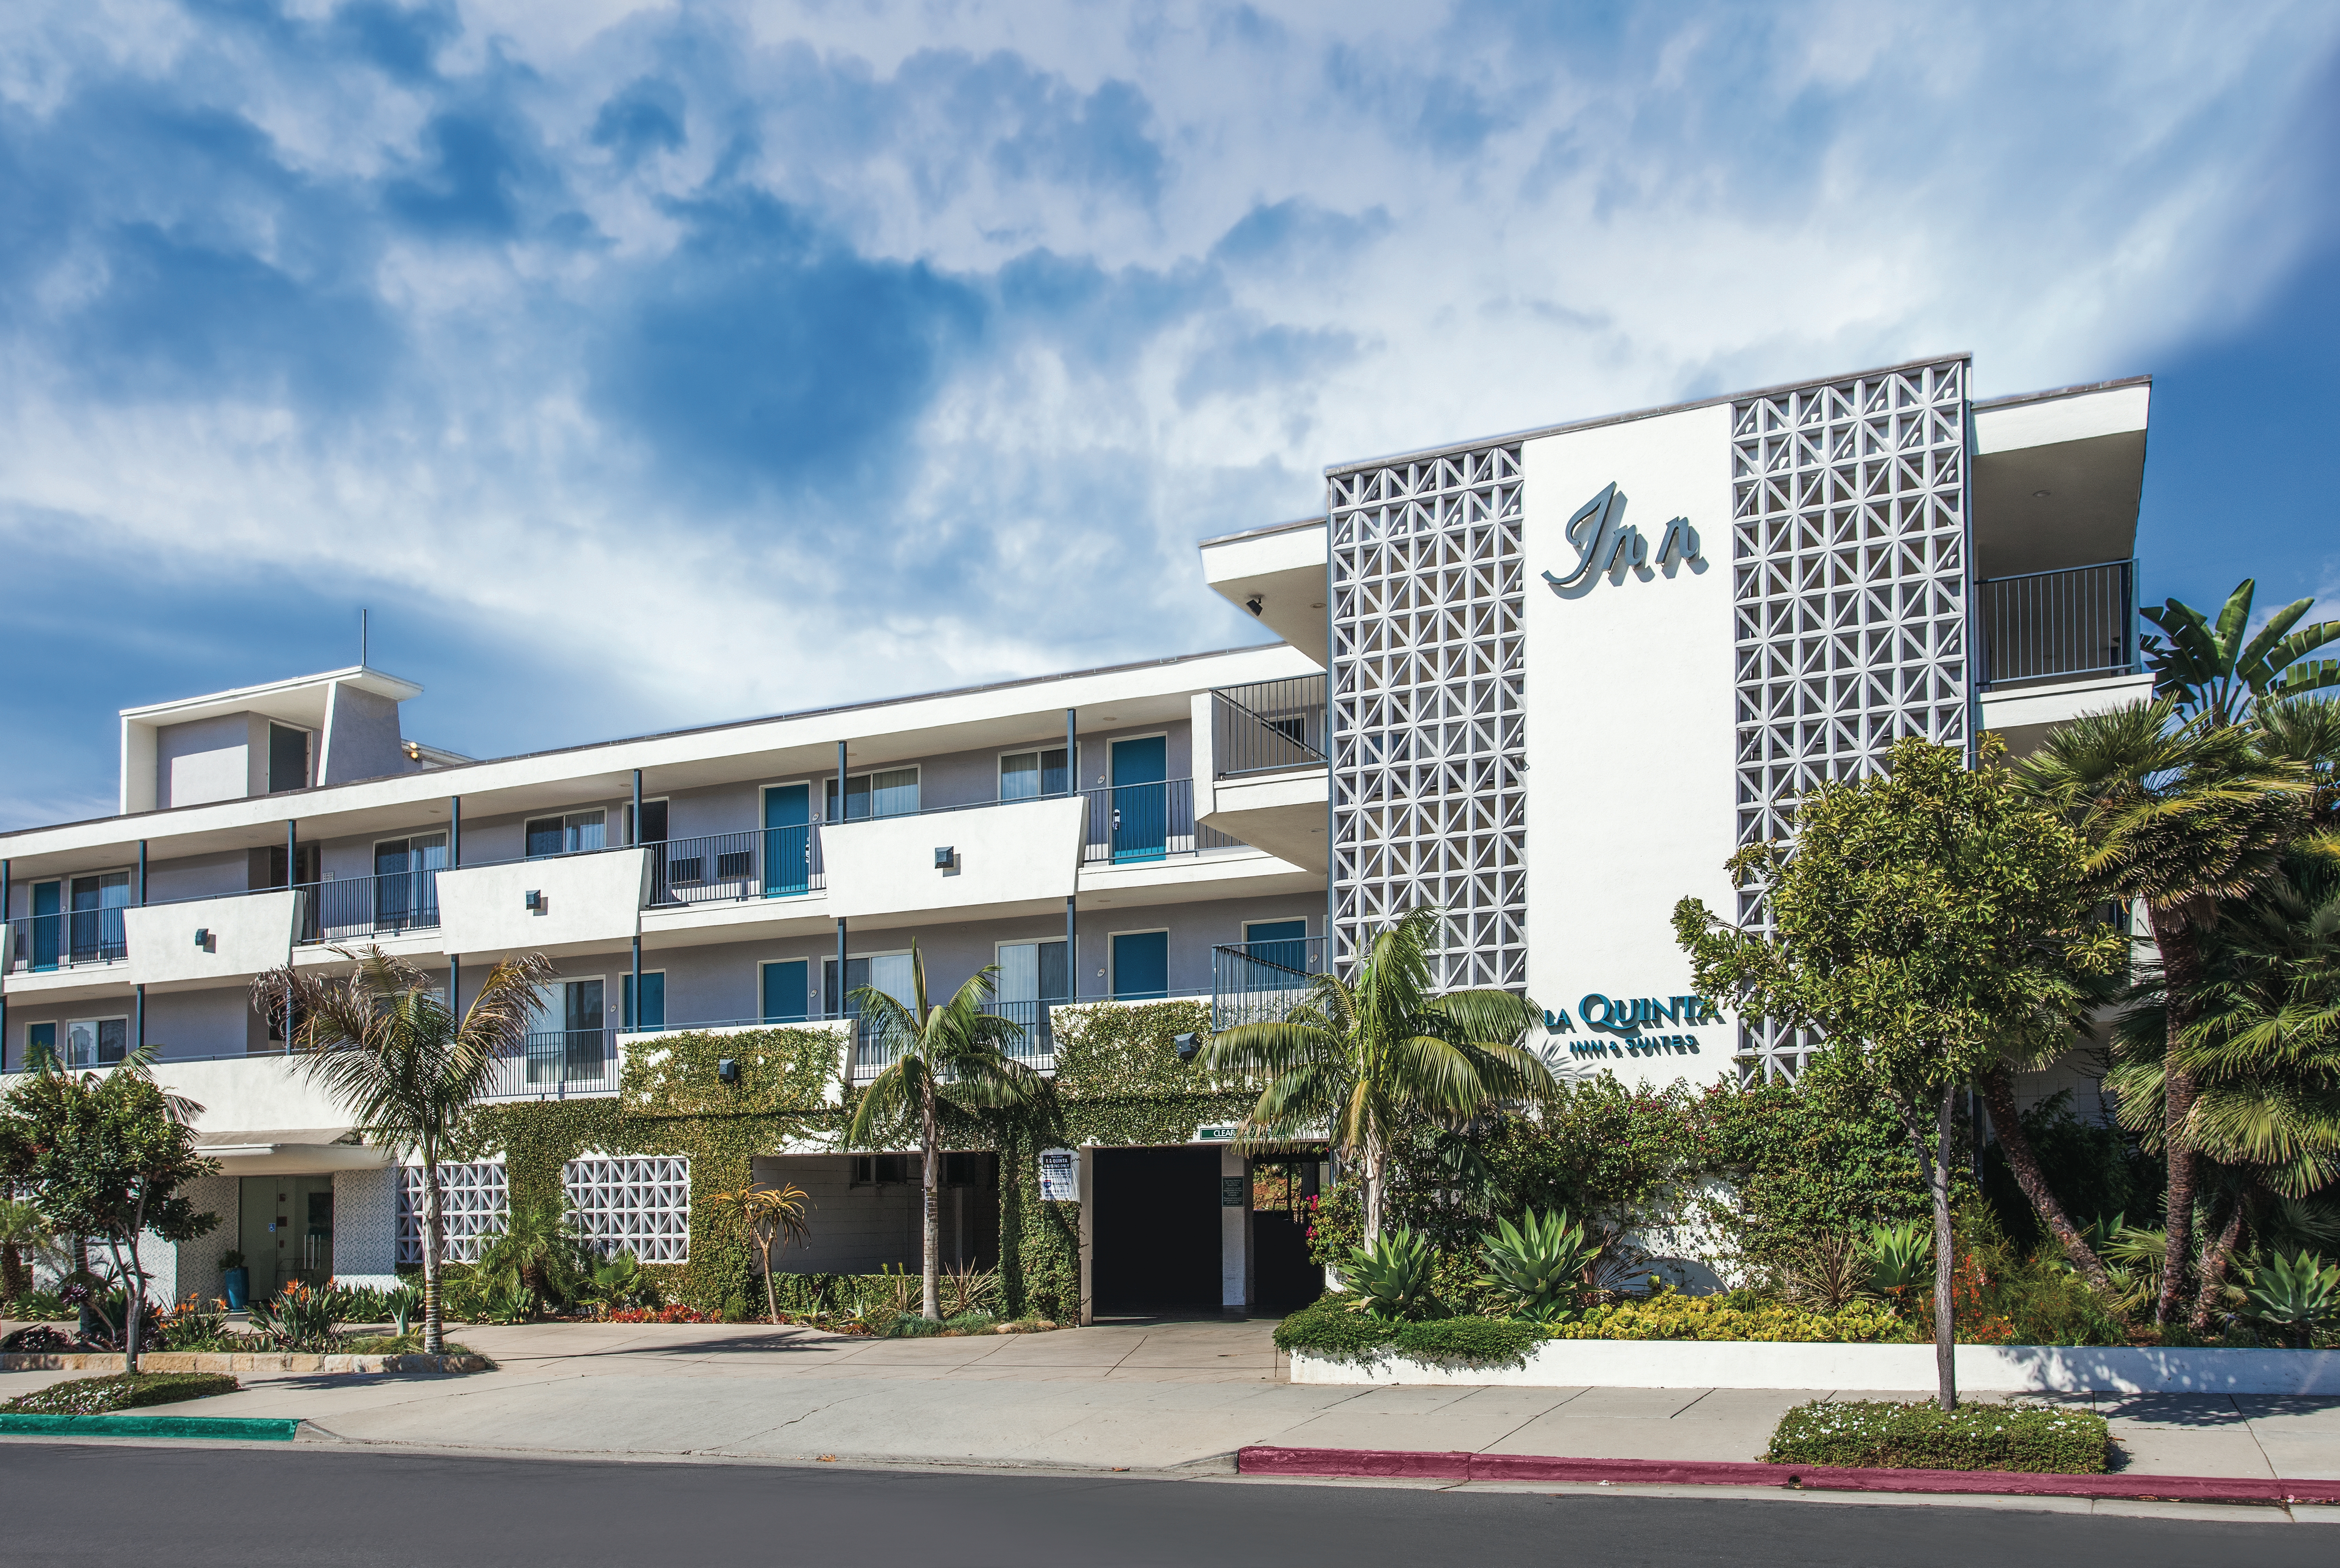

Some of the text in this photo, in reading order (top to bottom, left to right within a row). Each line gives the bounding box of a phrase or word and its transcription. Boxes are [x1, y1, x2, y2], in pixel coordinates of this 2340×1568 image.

[1541, 481, 1698, 585] Inn
[1544, 993, 1719, 1030] LA QUINTA
[1570, 1034, 1694, 1052] INN & SUITES
